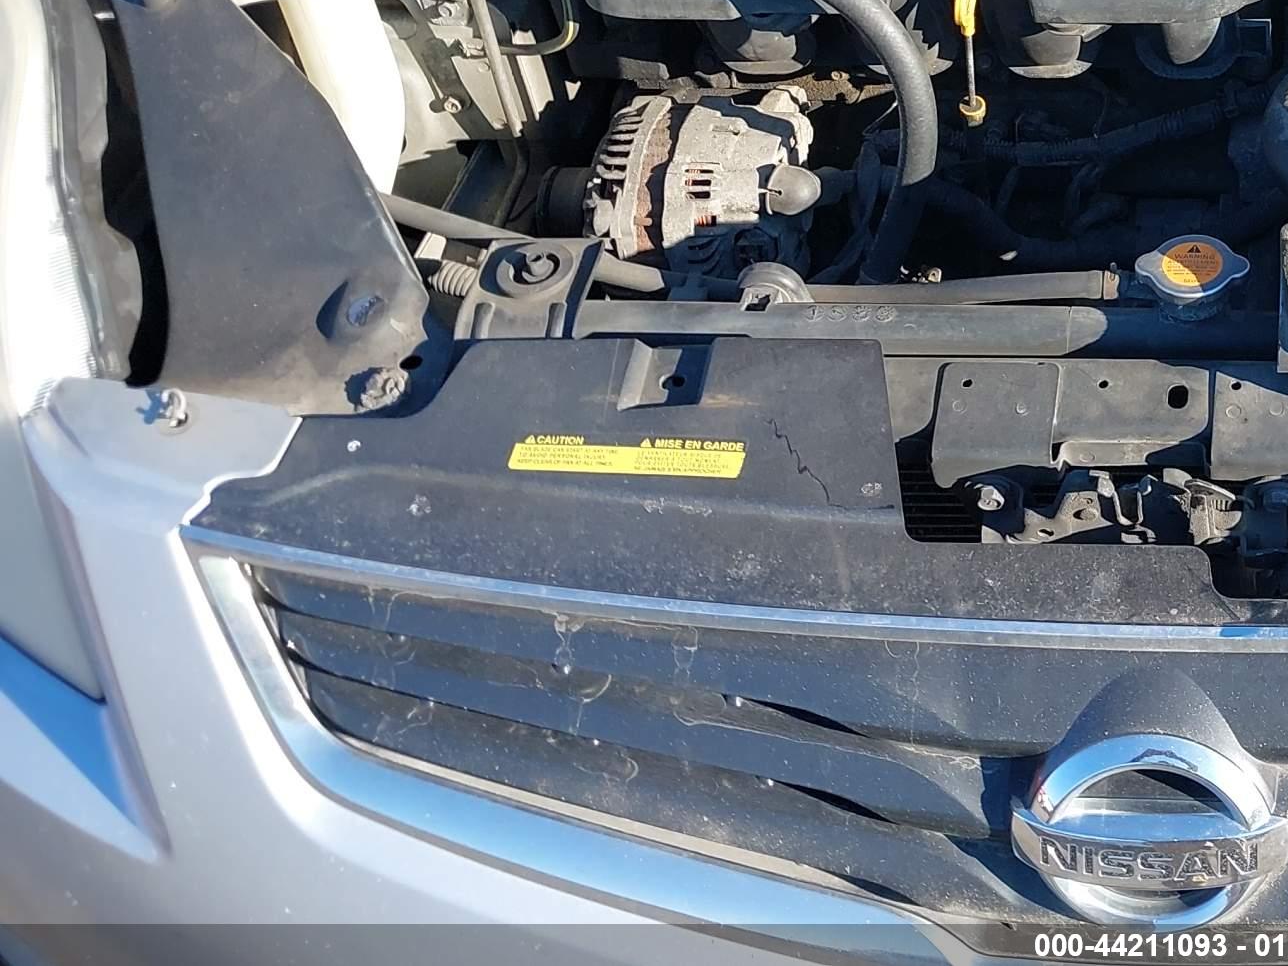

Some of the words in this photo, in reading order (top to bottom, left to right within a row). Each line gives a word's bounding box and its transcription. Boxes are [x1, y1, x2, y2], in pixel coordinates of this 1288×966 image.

[536, 435, 584, 445] CAUTION
[654, 439, 686, 449] MISE
[687, 440, 706, 450] EN
[706, 441, 744, 452] GARDE
[1040, 836, 1259, 880] NISSAN
